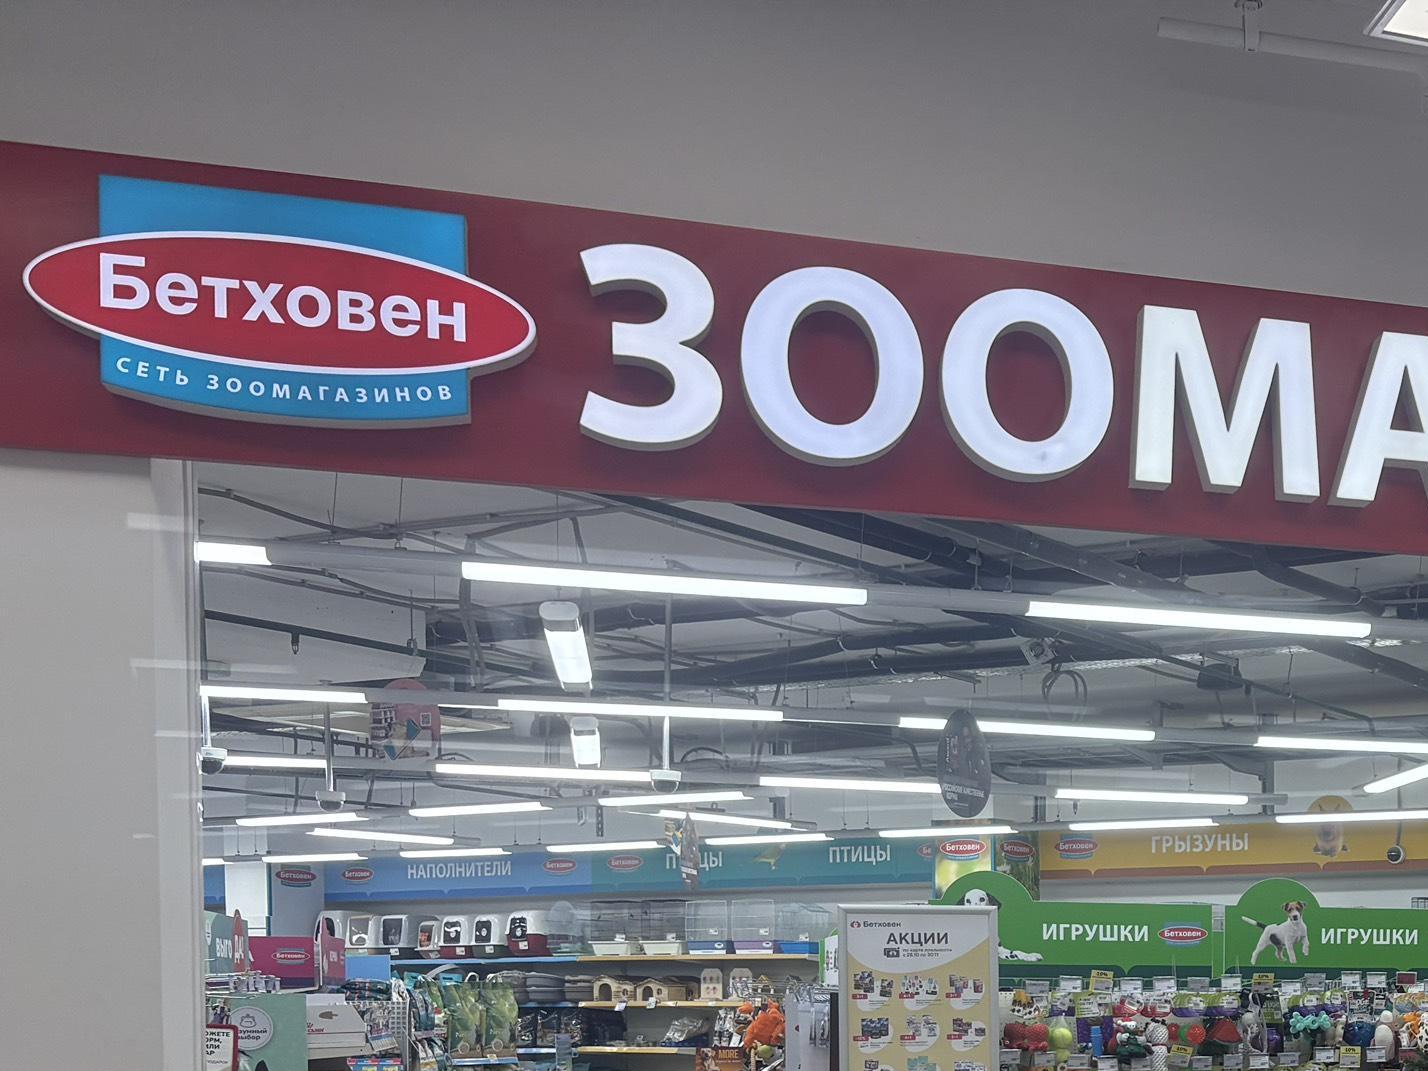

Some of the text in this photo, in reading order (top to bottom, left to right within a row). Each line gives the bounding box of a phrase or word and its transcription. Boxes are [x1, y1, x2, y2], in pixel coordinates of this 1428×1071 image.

[98, 251, 468, 343] Бетховен
[115, 356, 454, 403] СЕТЬ ЗООМАГАЗИНОВ
[945, 843, 980, 852] Бетховен
[1059, 842, 1093, 851] Бетховен
[1151, 832, 1250, 854] ГРЫЗУНЫ
[666, 850, 723, 870] ПЦЫ
[829, 844, 891, 866] ПТИЦЫ
[407, 860, 512, 880] НАПОЛНИТЕЛИ
[863, 920, 901, 928] Бетховен
[1042, 923, 1149, 943] ИГРУШКИ
[1163, 929, 1202, 938] Бетховен
[886, 932, 948, 947] АКЦИИ
[1320, 927, 1419, 946] ИГРУШКИ
[718, 1049, 738, 1059] MORE
